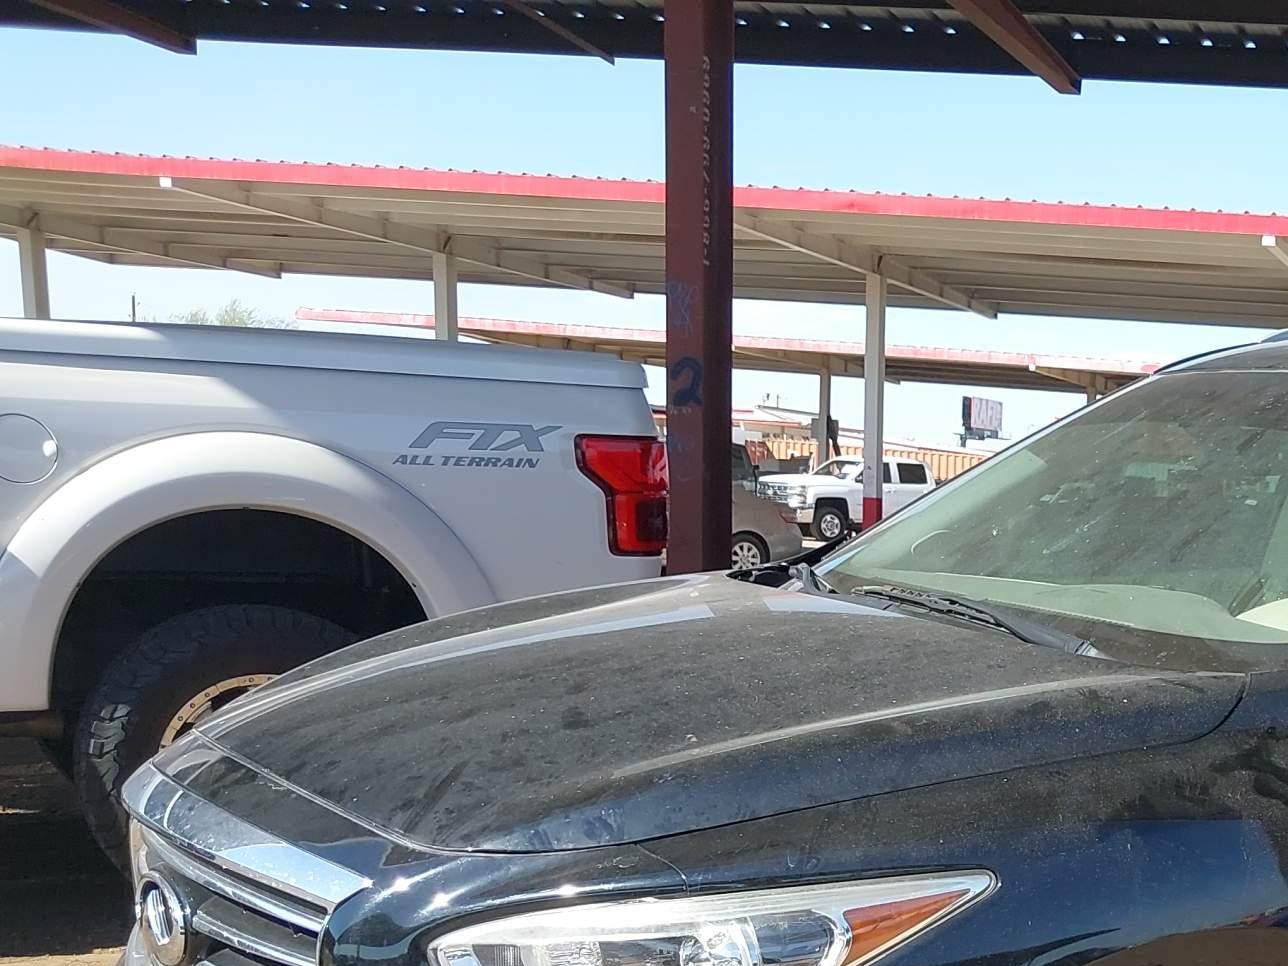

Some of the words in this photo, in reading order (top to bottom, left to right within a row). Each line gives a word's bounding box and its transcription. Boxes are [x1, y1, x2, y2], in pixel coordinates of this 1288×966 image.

[671, 355, 704, 407] 2
[408, 421, 563, 452] FTX
[392, 454, 435, 466] ALL
[441, 455, 540, 469] TERRAIN
